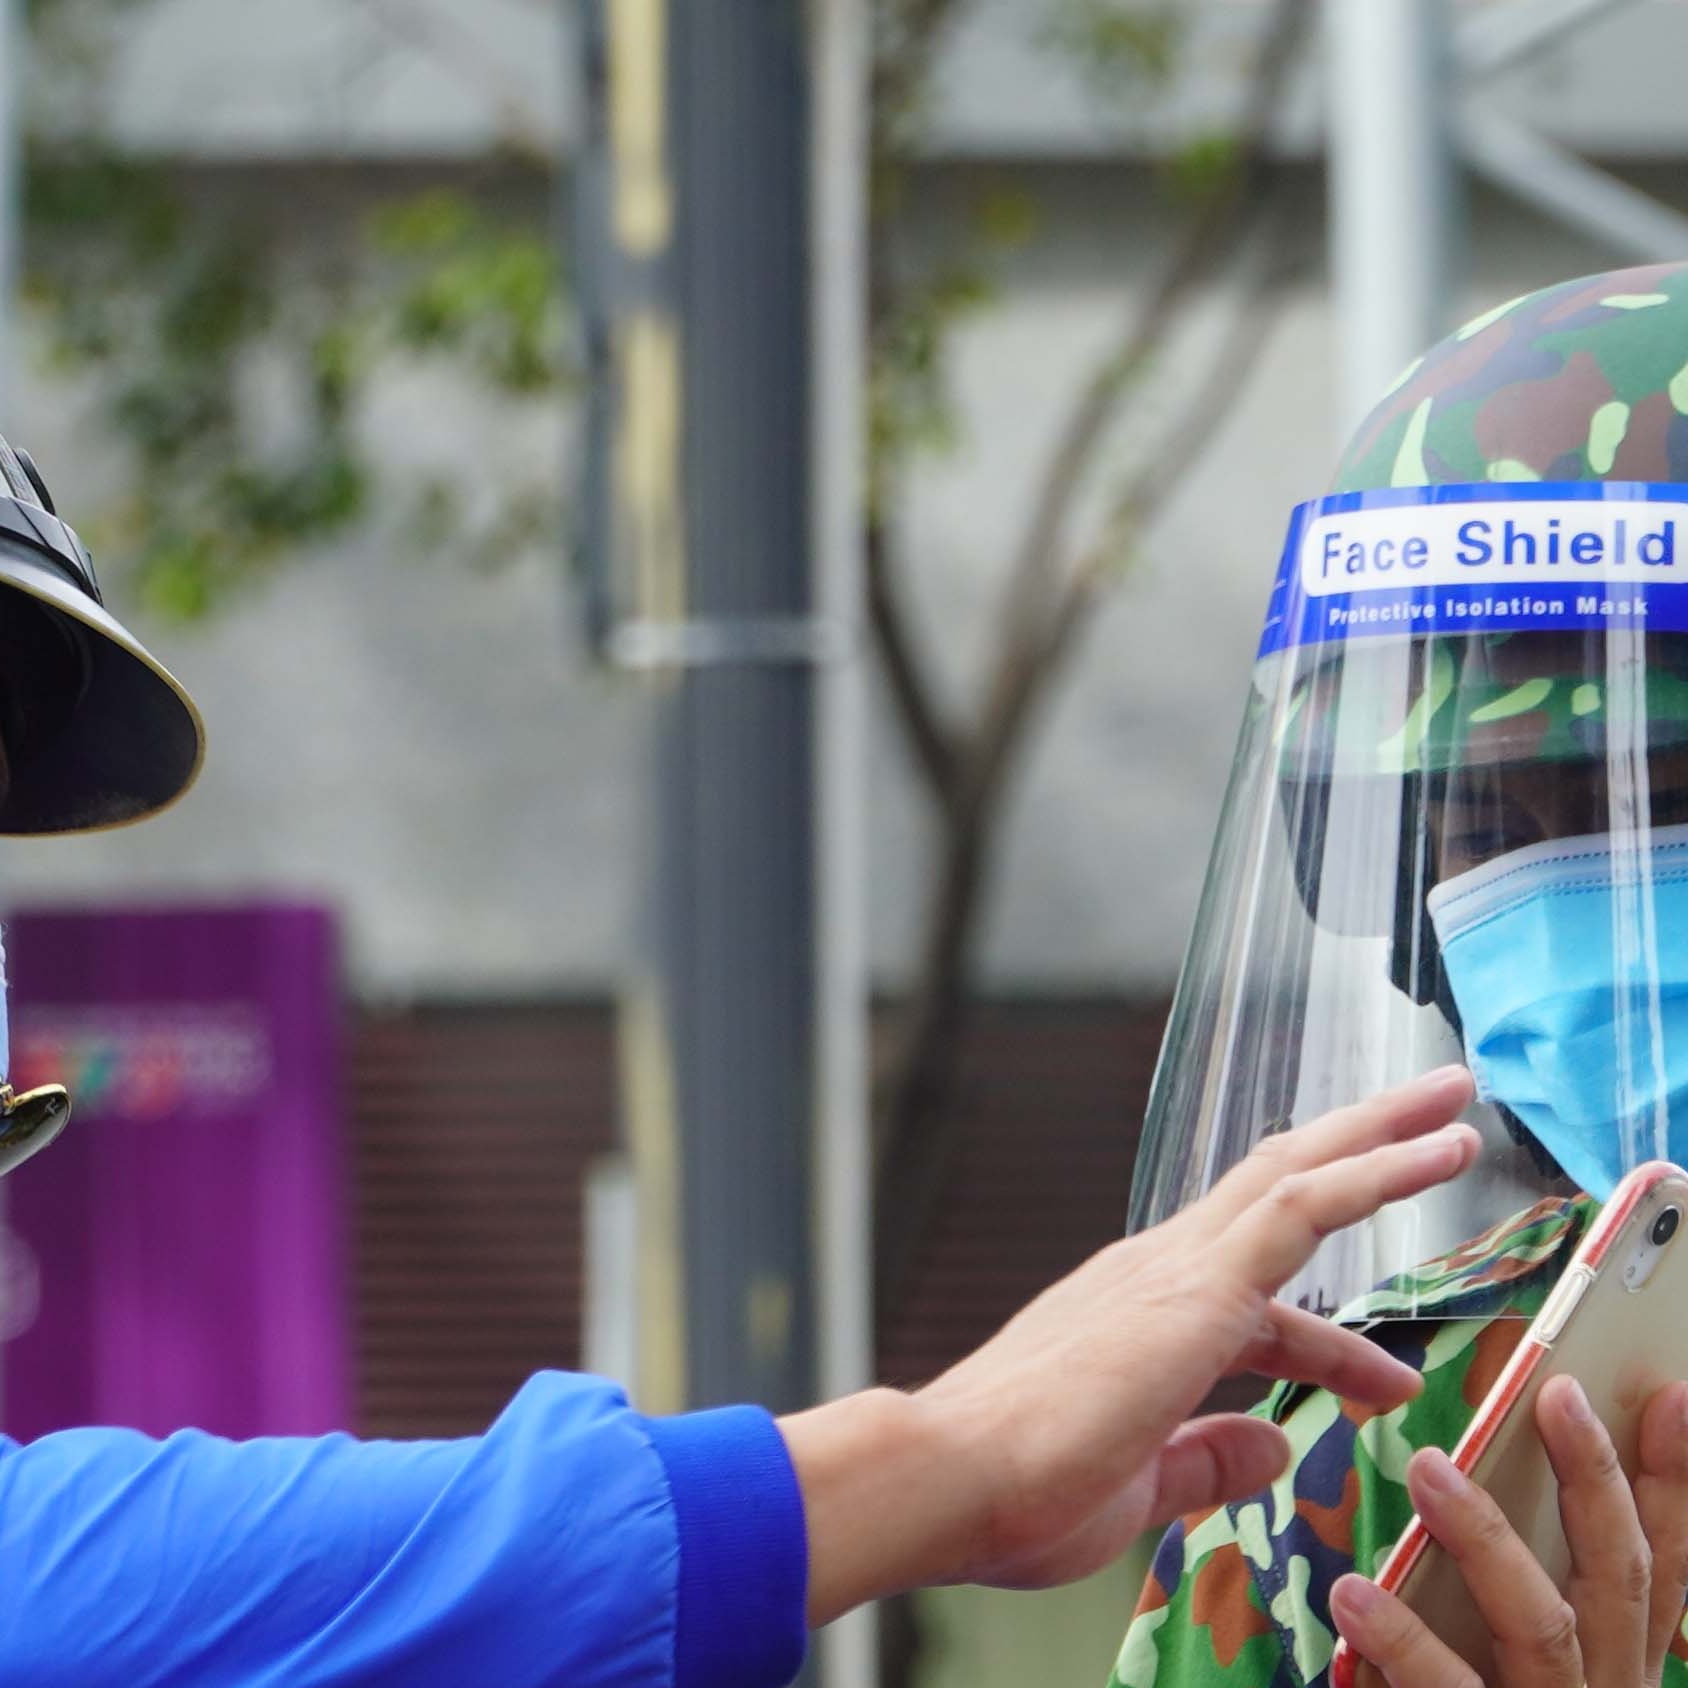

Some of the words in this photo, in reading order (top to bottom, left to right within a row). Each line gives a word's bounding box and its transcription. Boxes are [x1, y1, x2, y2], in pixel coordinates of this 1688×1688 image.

[1321, 532, 1429, 579] Face
[1456, 519, 1676, 567] Shield
[1328, 599, 1436, 626] Protective
[1445, 597, 1565, 618] Isolation
[1575, 596, 1649, 617] Mask
